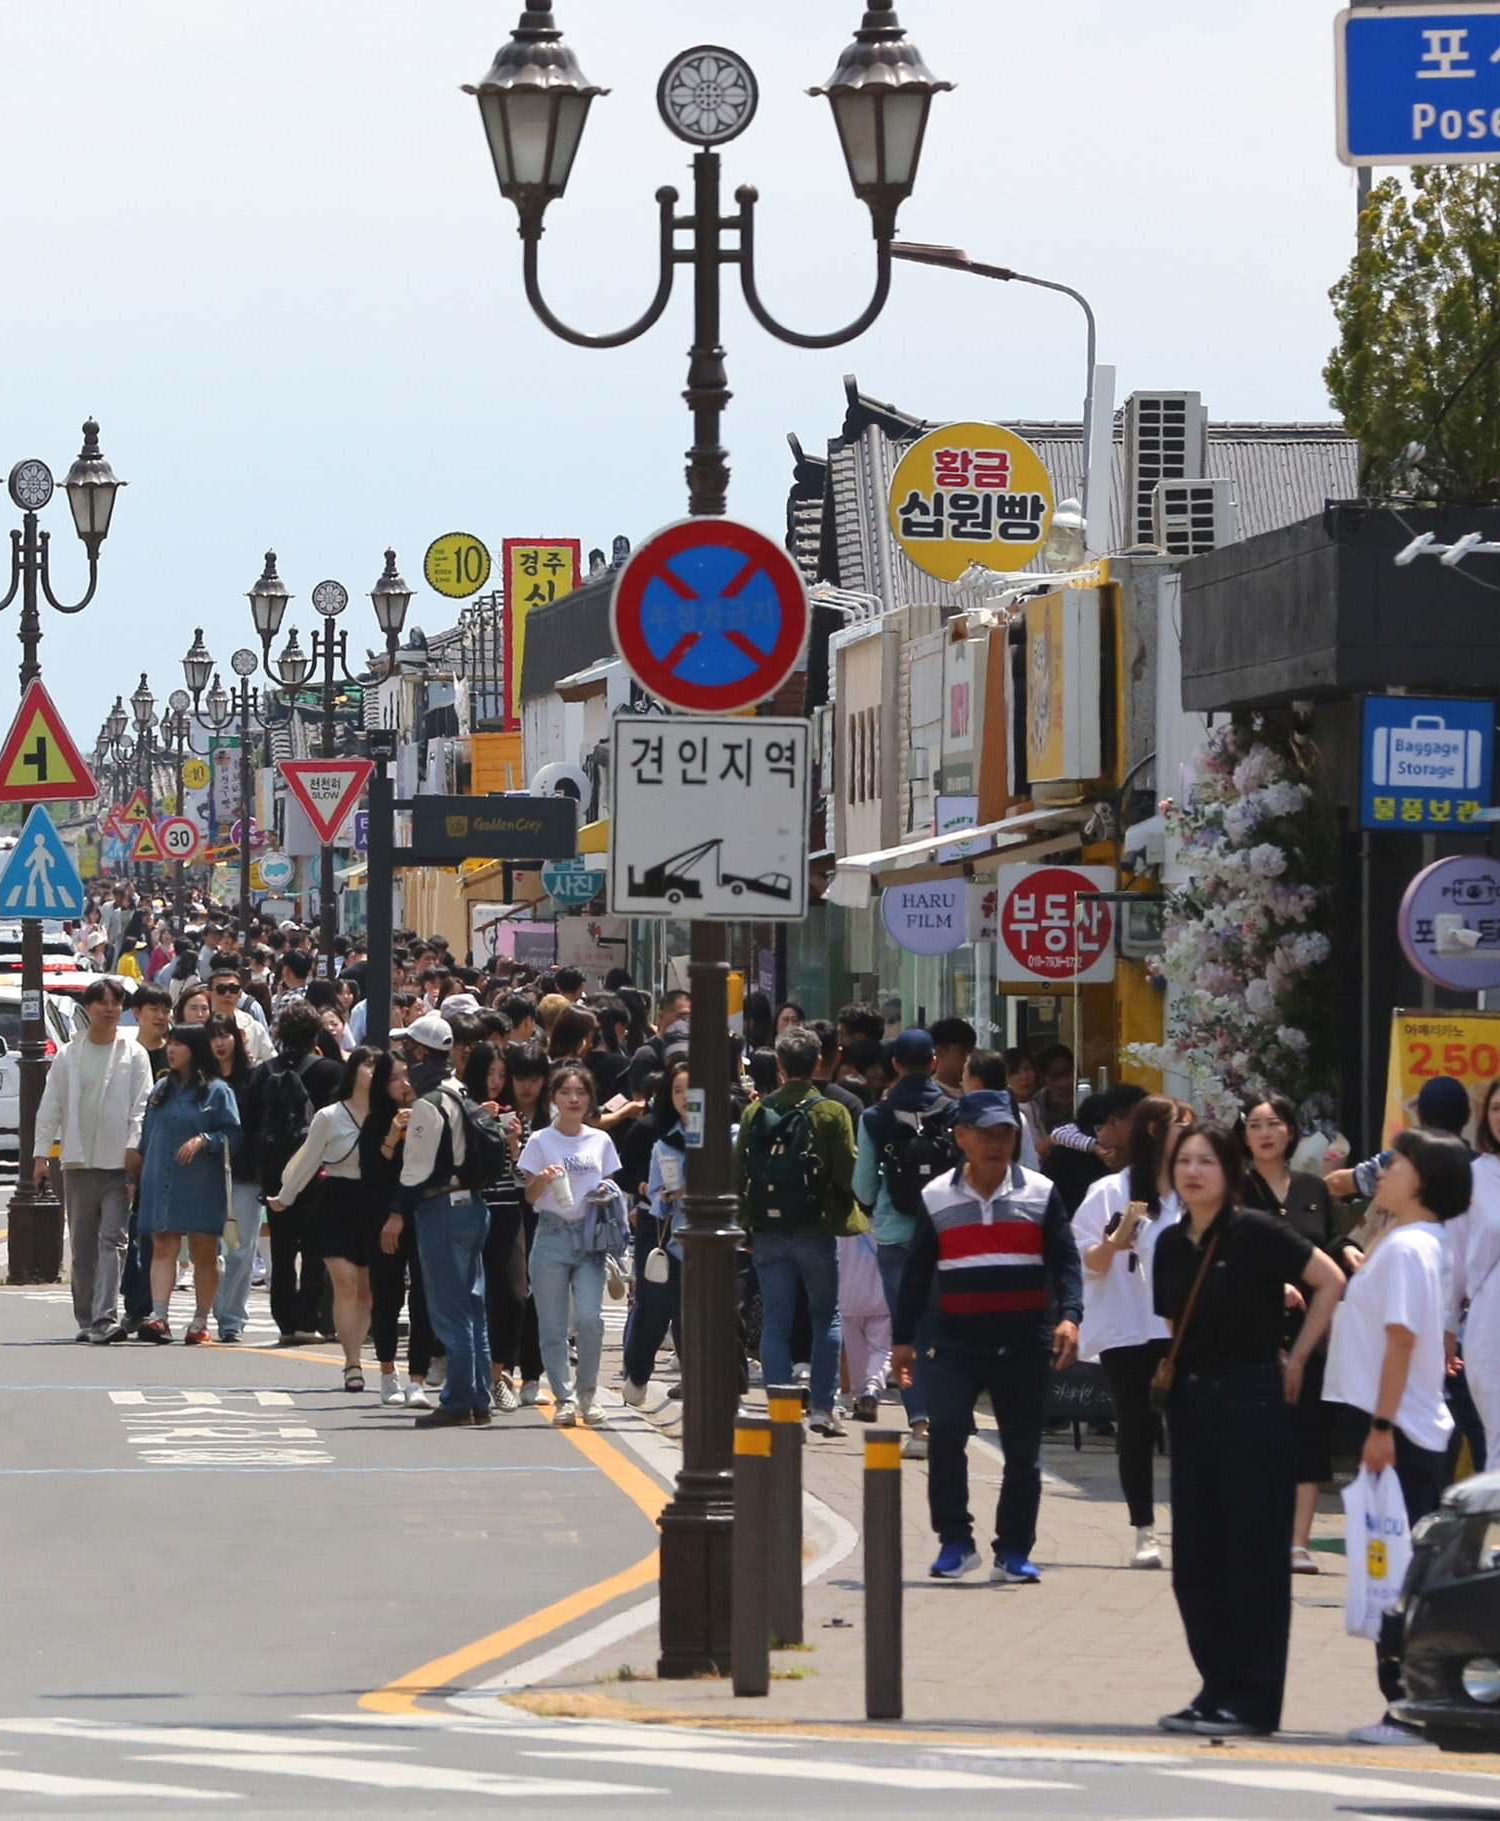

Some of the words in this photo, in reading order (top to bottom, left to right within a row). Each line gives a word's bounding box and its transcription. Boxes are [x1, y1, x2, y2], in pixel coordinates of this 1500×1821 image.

[1416, 29, 1500, 78] 포
[934, 449, 1010, 490] 황금
[899, 490, 1046, 542] 십원빵
[454, 545, 483, 584] 10
[519, 550, 566, 577] 경주
[1395, 738, 1459, 756] Baggage
[630, 736, 798, 788] 견인지역
[1398, 761, 1455, 777] Storage
[309, 777, 341, 791] 천천히
[311, 791, 340, 799] SLOW
[1373, 797, 1481, 822] 물품보관
[473, 817, 513, 832] Golden
[169, 830, 190, 848] 30
[552, 875, 593, 897] 사진
[902, 893, 956, 909] HARU
[906, 914, 953, 929] FILM
[1009, 893, 1103, 951] 부동산
[1404, 1024, 1464, 1037] 아메리카노
